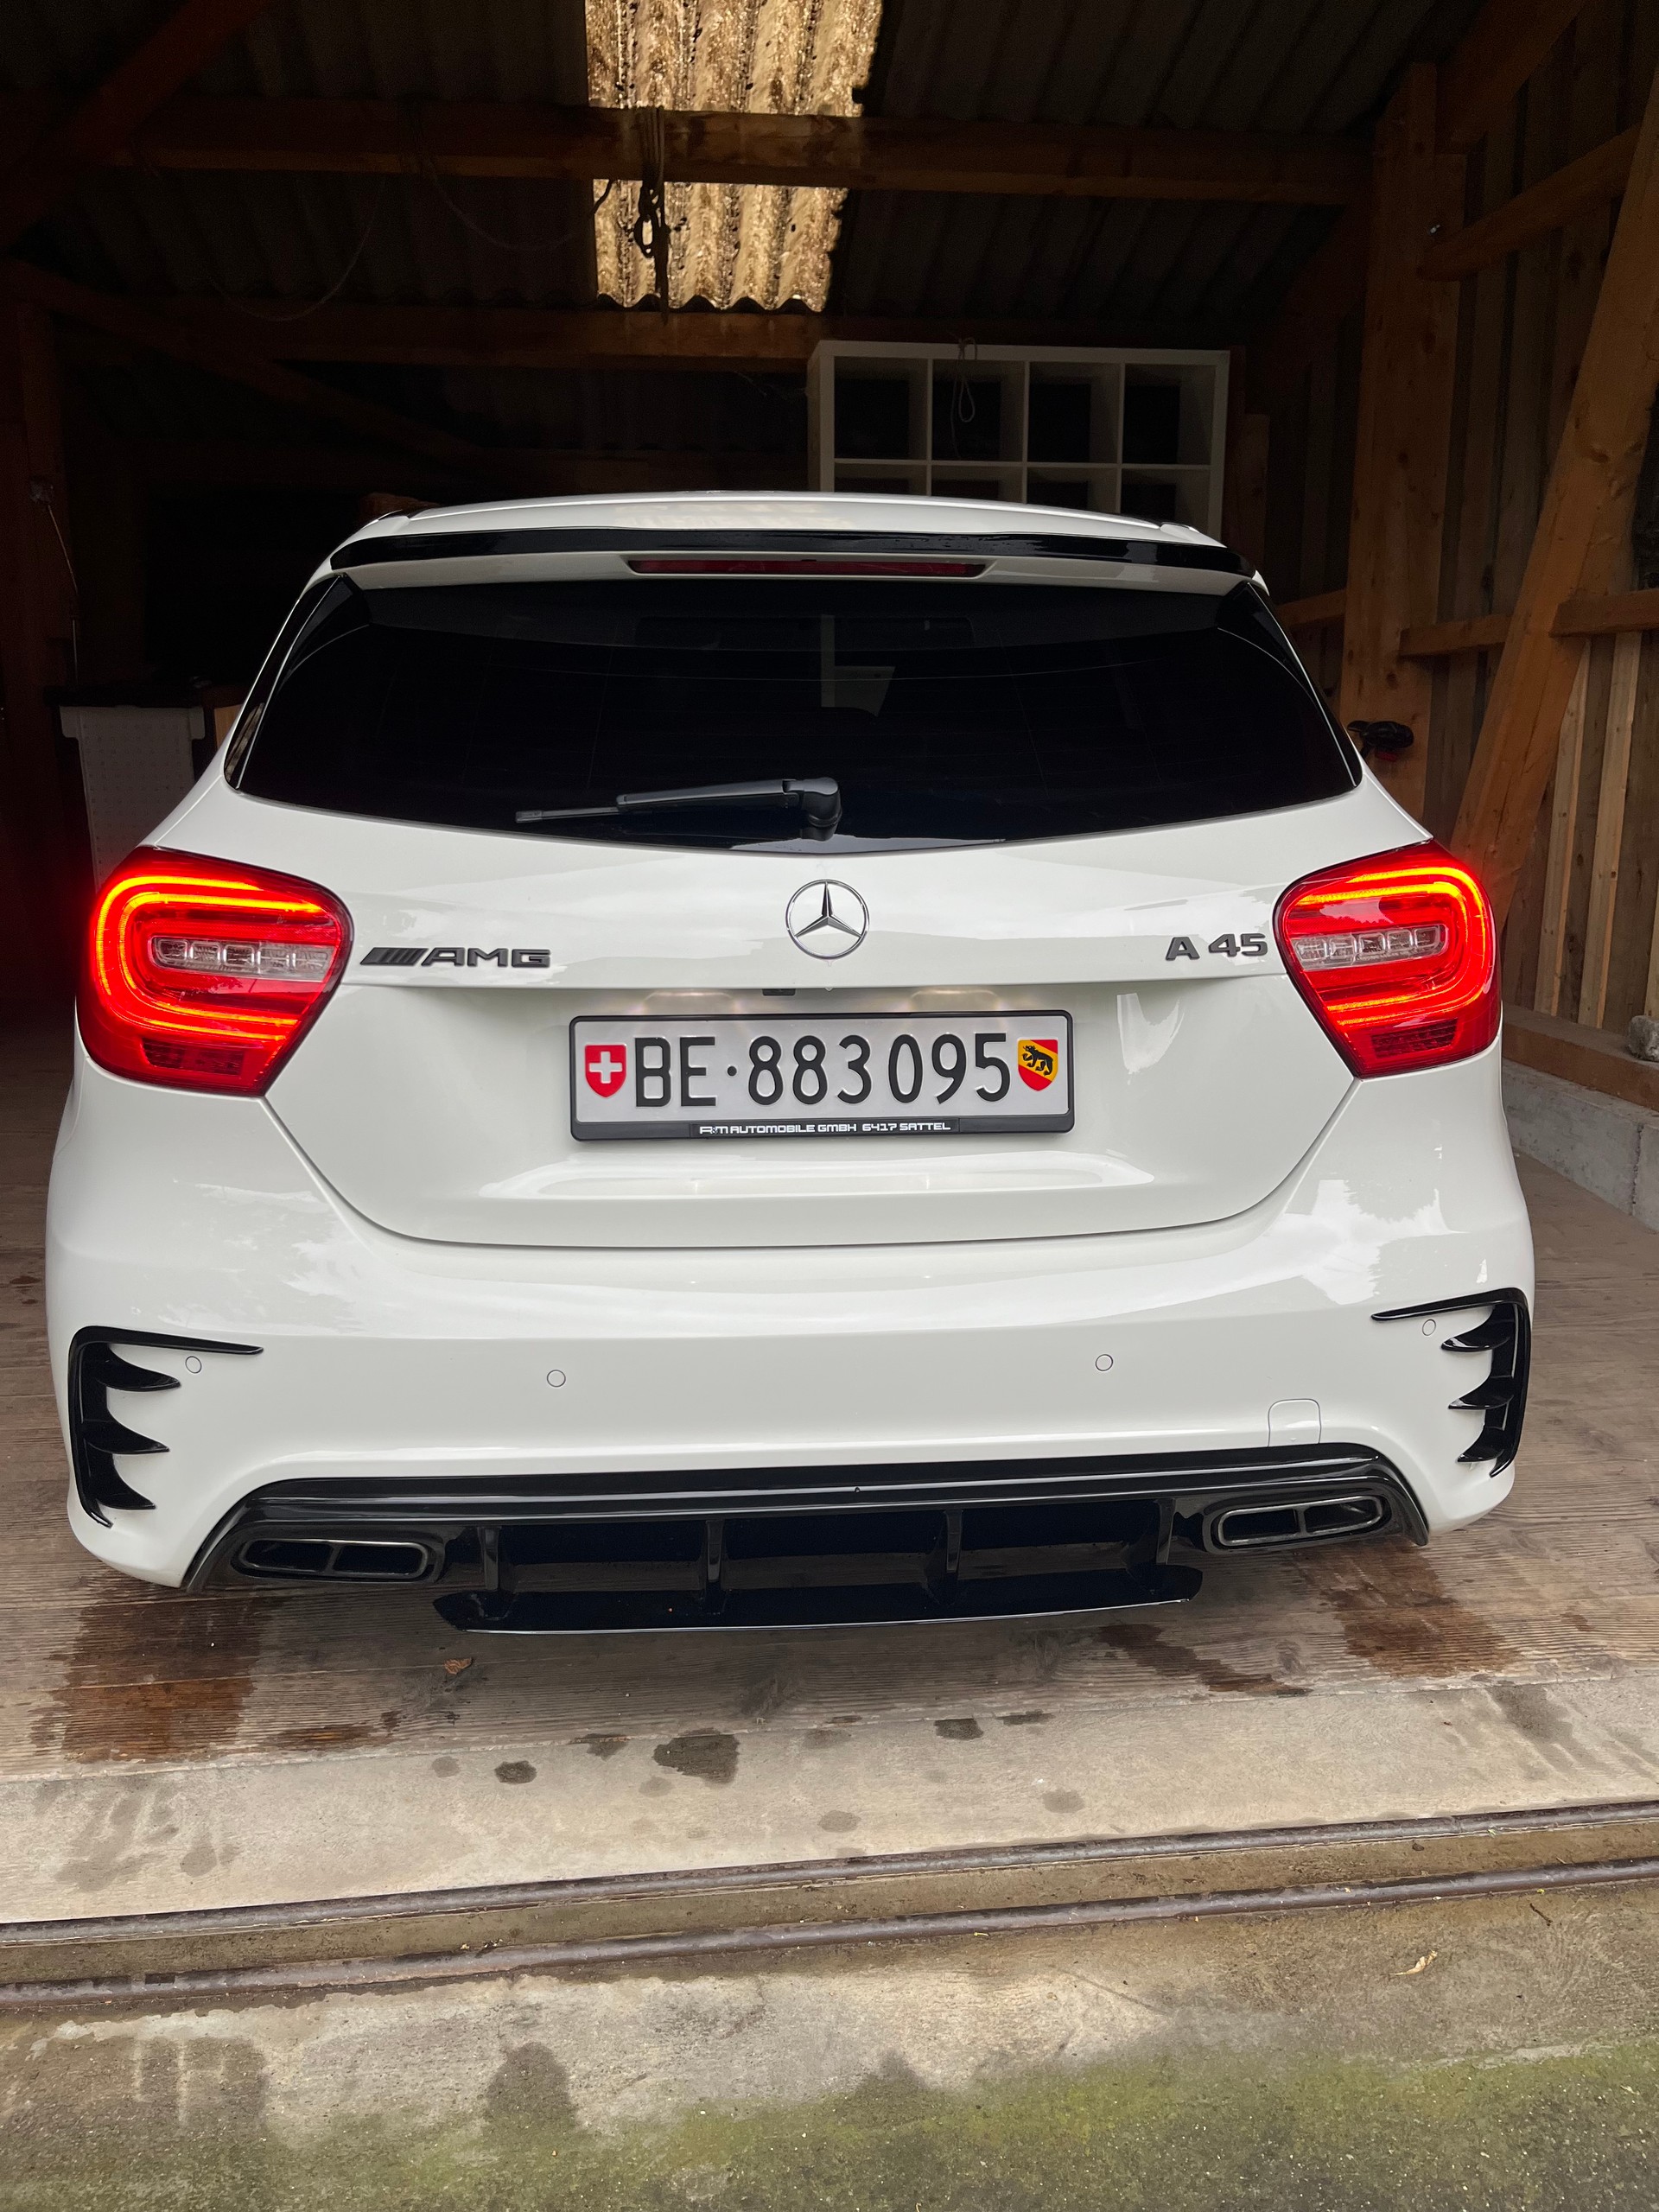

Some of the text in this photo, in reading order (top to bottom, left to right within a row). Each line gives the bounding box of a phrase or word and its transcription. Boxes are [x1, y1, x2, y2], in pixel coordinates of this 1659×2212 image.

[1165, 932, 1268, 961] A 45
[420, 947, 551, 968] AMG
[729, 1124, 816, 1135] AUTOMOBILE
[817, 1123, 857, 1133] GMBH
[862, 1122, 897, 1132] 6417
[899, 1122, 951, 1131] SATTEL
